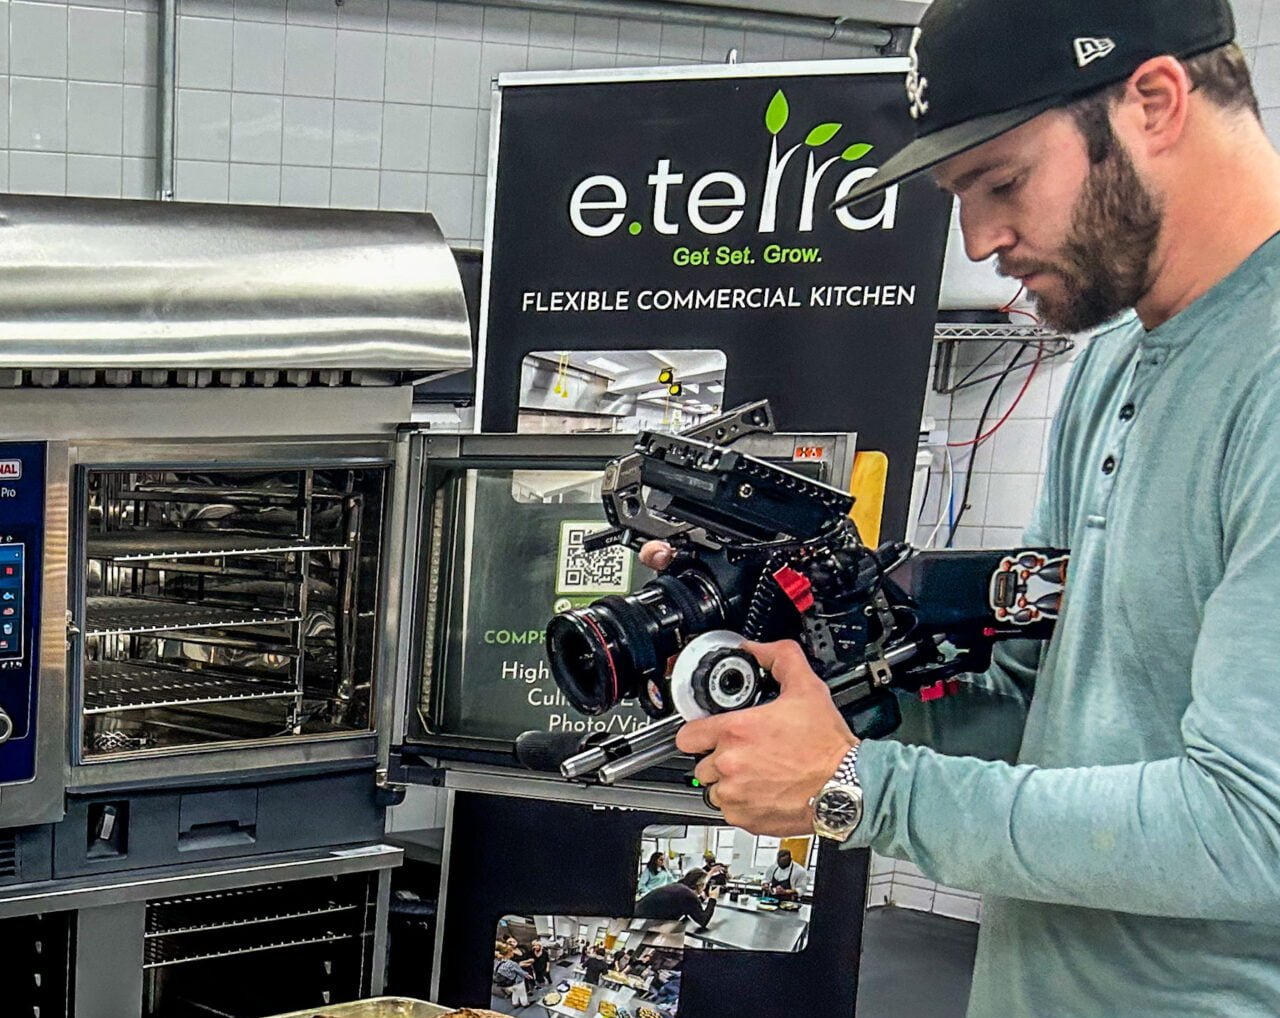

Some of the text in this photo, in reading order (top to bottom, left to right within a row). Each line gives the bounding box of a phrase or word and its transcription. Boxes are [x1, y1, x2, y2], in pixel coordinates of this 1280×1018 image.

[569, 130, 899, 237] e.terra
[673, 245, 822, 266] Get Set. Grow.
[522, 285, 916, 312] FLEXIBLE COMMERCIAL KITCHEN
[1, 487, 16, 498] Pro
[502, 661, 549, 684] High
